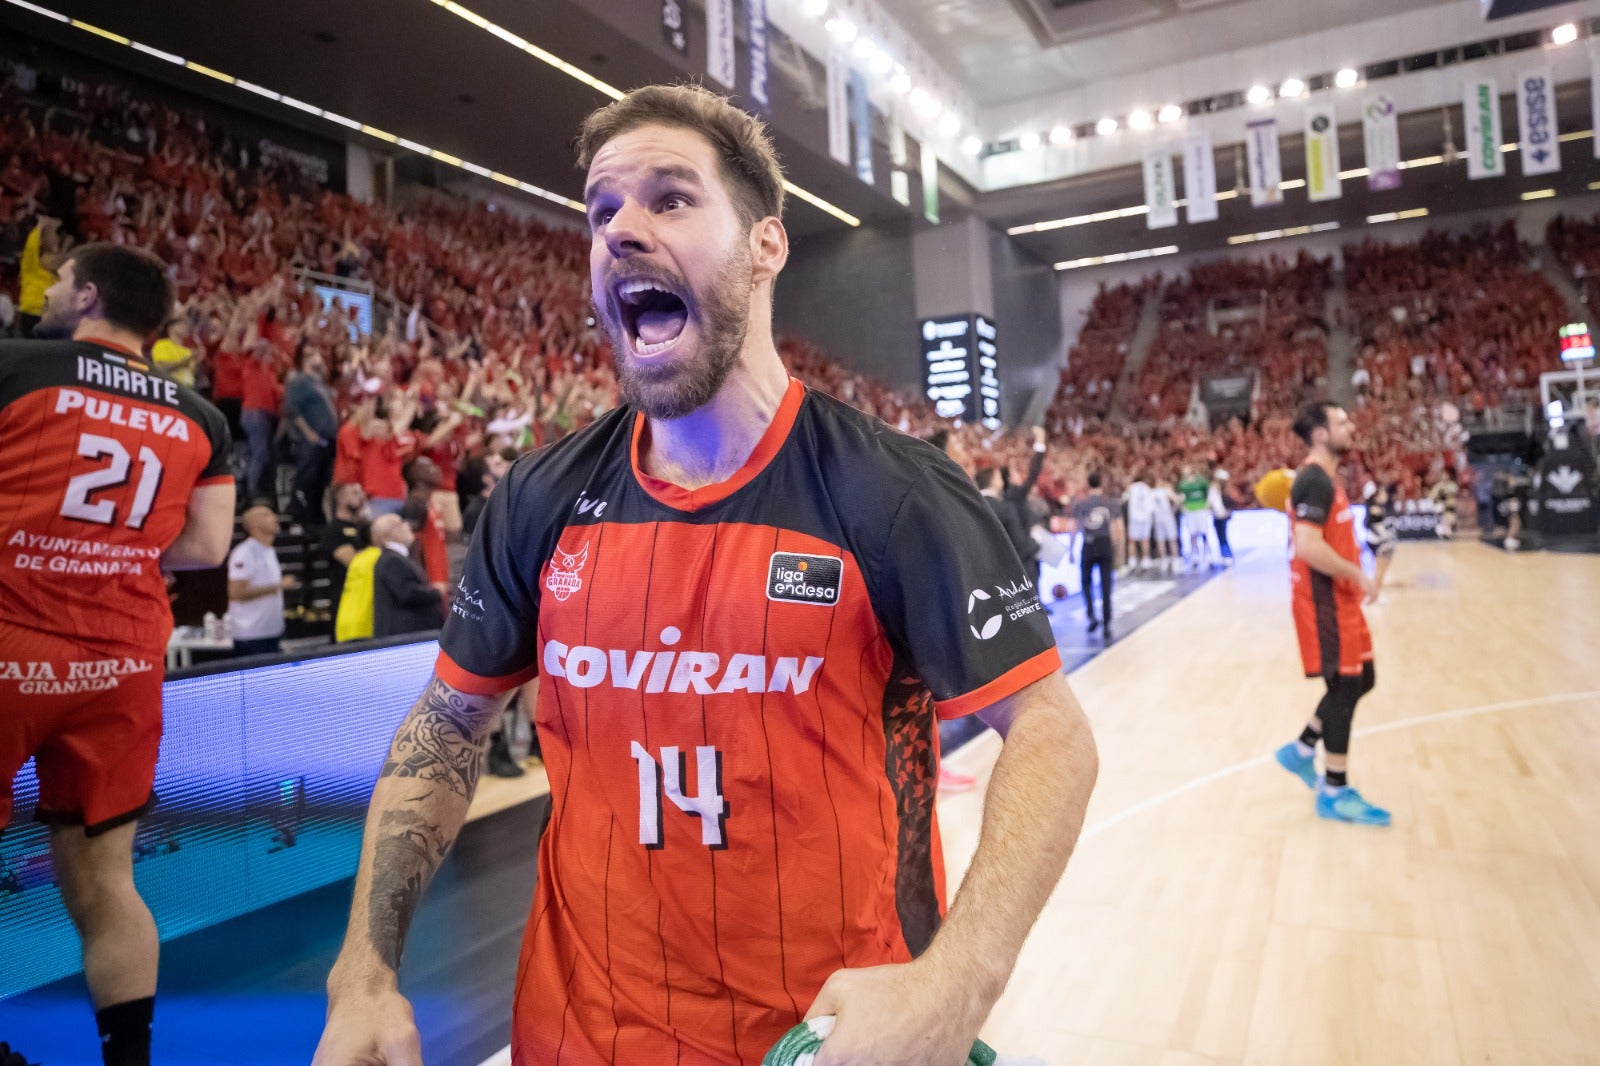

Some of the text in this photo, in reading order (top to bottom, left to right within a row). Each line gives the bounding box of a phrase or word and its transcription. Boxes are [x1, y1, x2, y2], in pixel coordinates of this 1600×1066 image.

[77, 356, 180, 405] IRIARTE
[55, 388, 189, 442] PULEVA
[60, 433, 163, 530] 21
[15, 554, 143, 576] DE GRANADA
[776, 567, 804, 583] liga
[774, 582, 835, 599] endesa
[67, 656, 153, 680] RURAL
[18, 677, 120, 695] GRANADA
[630, 740, 731, 850] 14
